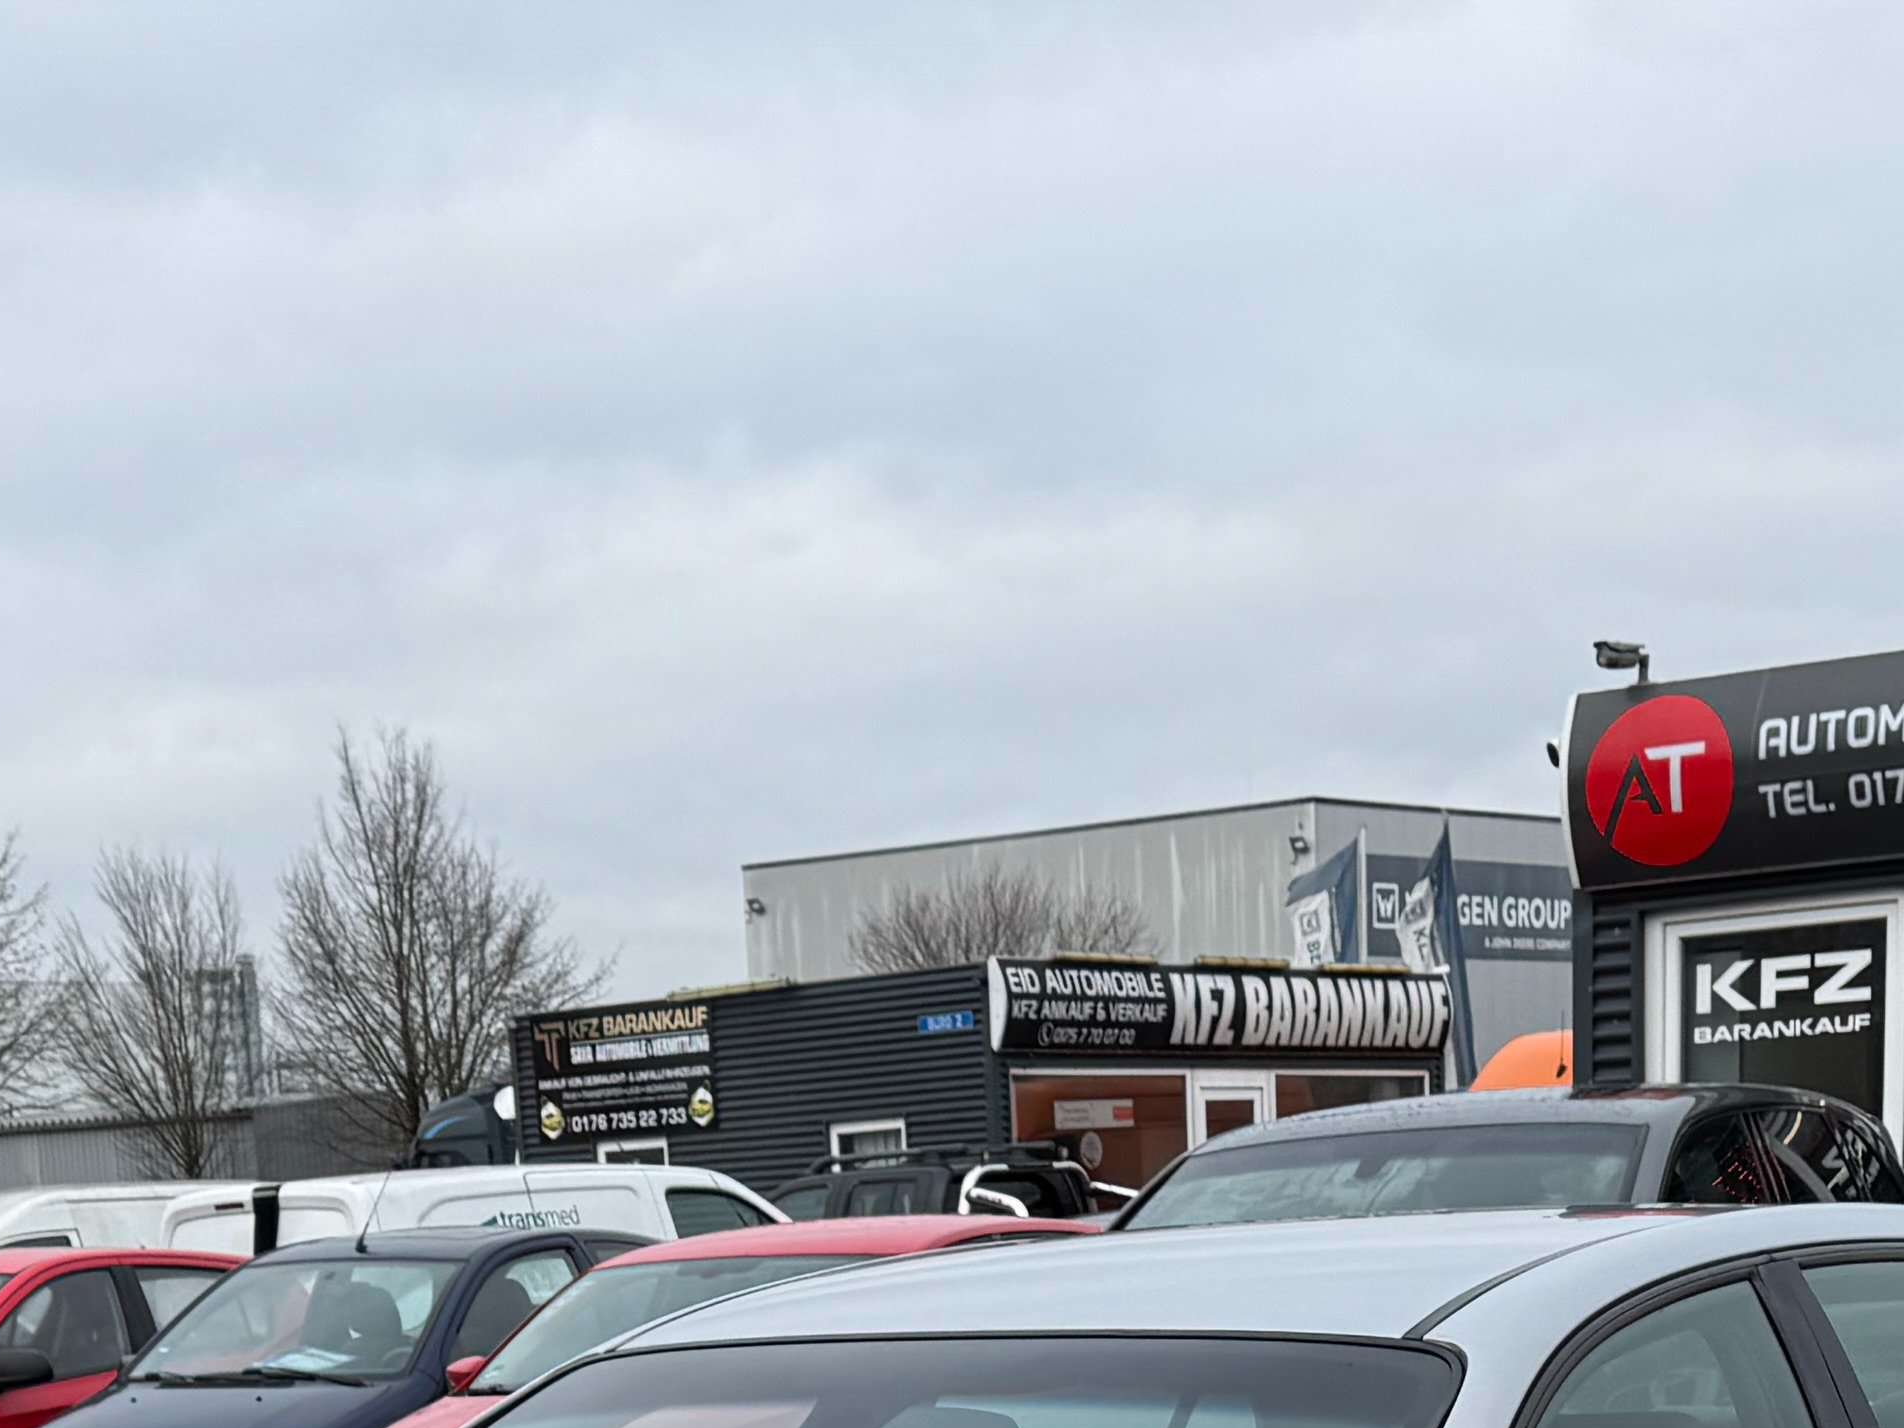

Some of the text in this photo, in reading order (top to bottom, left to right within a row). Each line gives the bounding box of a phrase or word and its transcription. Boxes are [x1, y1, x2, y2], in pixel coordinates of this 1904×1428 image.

[1758, 780, 1836, 819] TEL.
[1502, 896, 1573, 930] GROUP
[1005, 967, 1167, 998] EID AUTOMOBILE
[1696, 948, 1872, 1014] KFZ
[567, 1006, 708, 1040] KFZ BARANKAUF
[1012, 999, 1038, 1019] KFZ
[1040, 1000, 1095, 1021] ANKAUF
[1109, 1002, 1168, 1023] VERKAUF
[1169, 972, 1449, 1048] KFZ BARANKAUF
[1694, 1013, 1871, 1044] BARANKAUF
[572, 1106, 687, 1133] 0176 735 22 733
[497, 1204, 581, 1230] transmed
